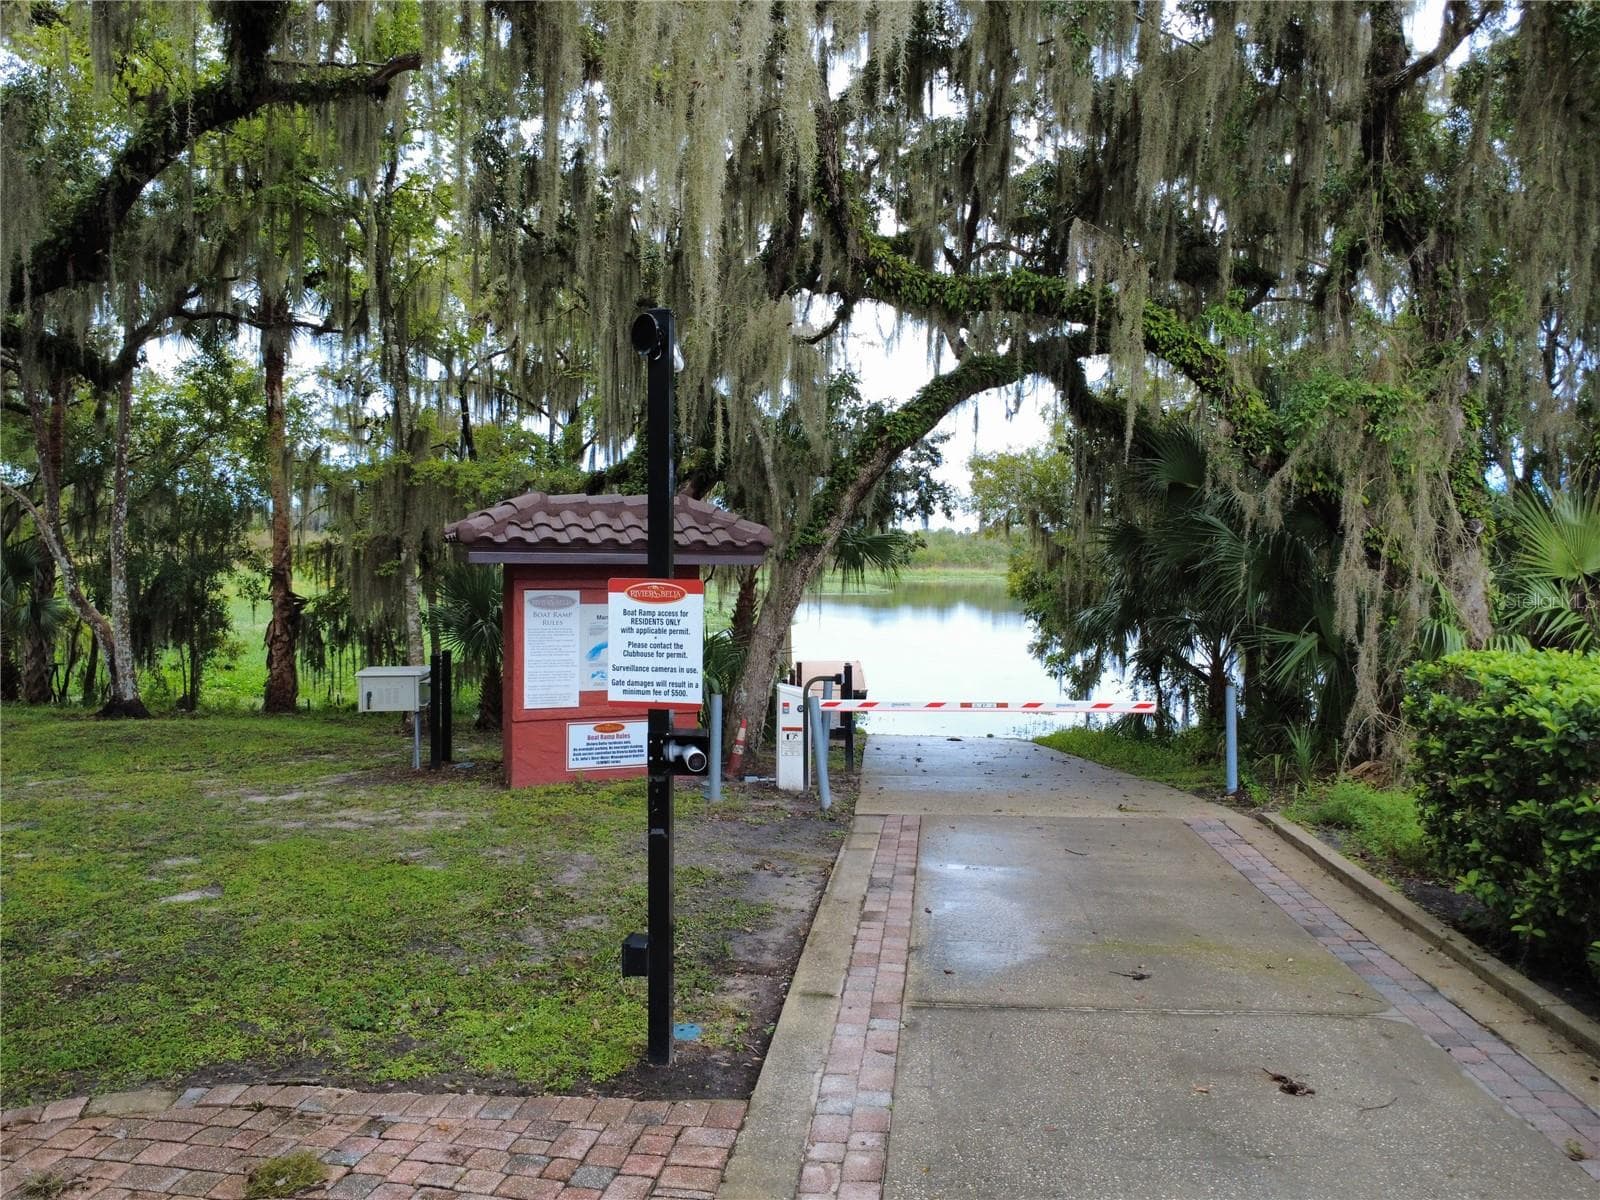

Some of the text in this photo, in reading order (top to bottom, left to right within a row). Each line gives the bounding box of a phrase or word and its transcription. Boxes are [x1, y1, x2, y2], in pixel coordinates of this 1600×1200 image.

[638, 609, 656, 617] Ramp
[630, 618, 681, 626] RESIDENTS ONLY
[636, 627, 668, 635] applicable
[669, 628, 690, 636] permit.
[627, 641, 683, 650] Please contact the
[623, 650, 688, 659] Clubhouse for permit.
[611, 664, 649, 672] Surveillance
[626, 680, 654, 688] damages
[622, 688, 651, 696] minimum
[671, 689, 688, 697] $500.
